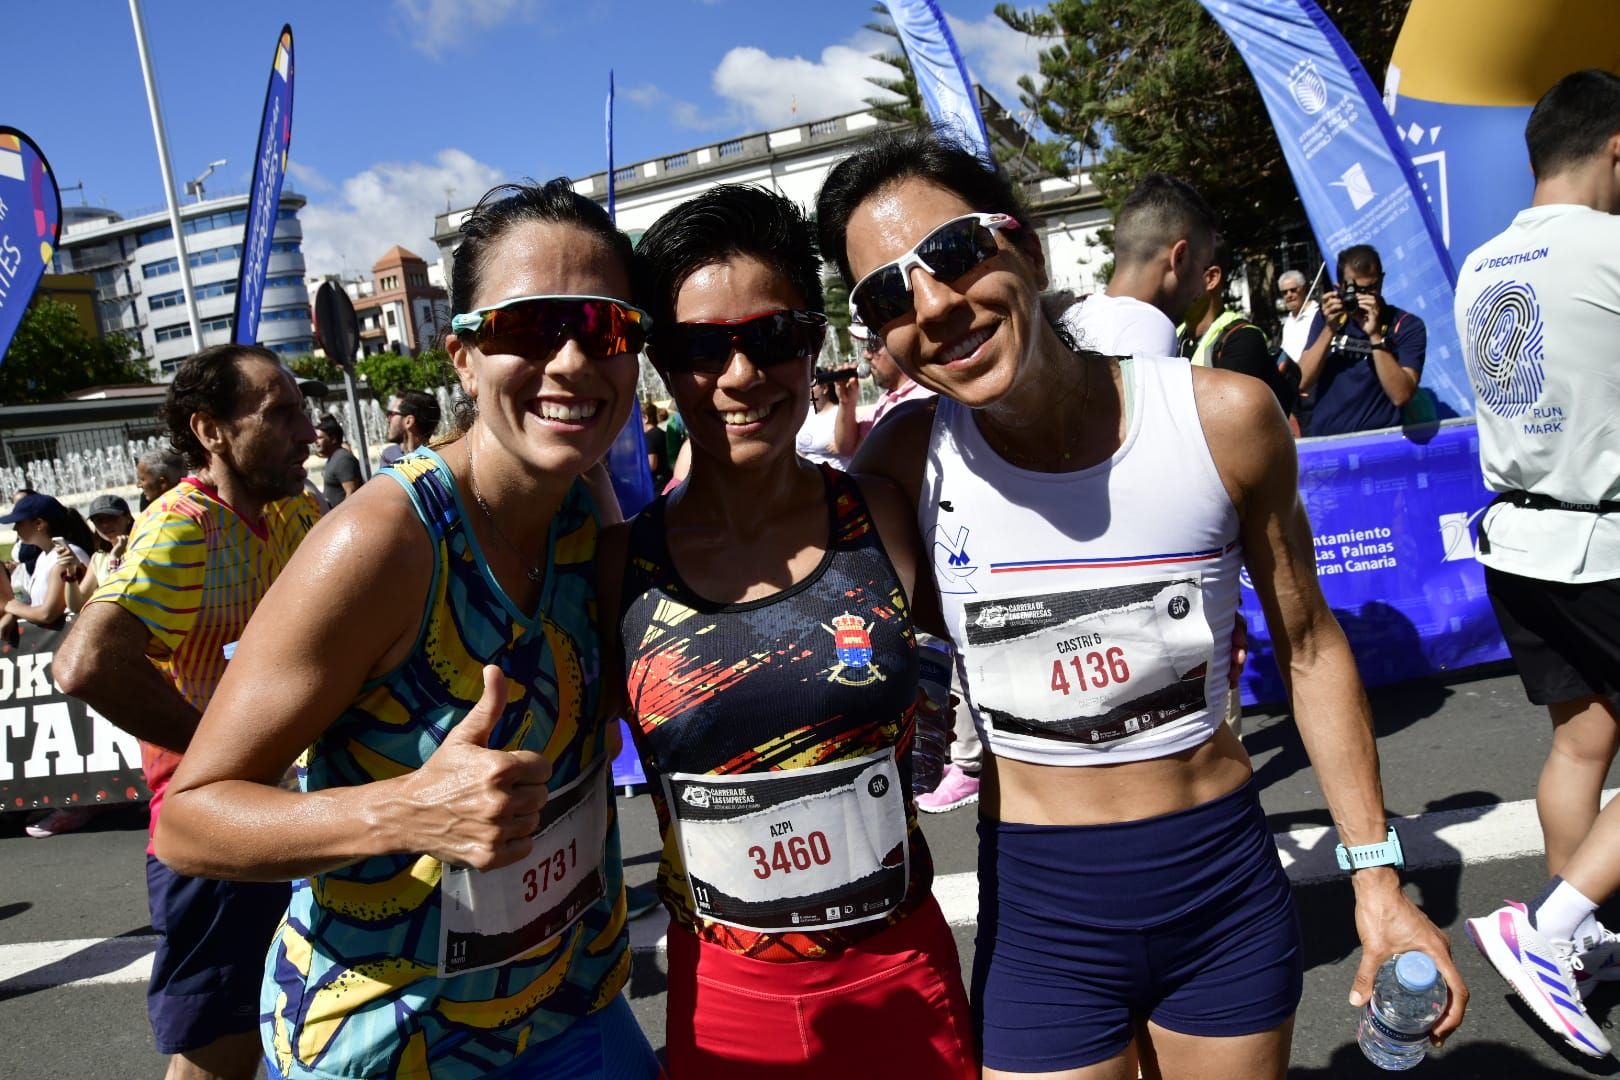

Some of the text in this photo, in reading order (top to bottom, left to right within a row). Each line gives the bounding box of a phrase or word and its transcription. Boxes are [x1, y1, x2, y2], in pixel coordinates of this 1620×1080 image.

[1488, 247, 1549, 269] DECATHLON
[1533, 406, 1563, 419] RUN
[1524, 422, 1564, 435] MARK
[1313, 526, 1391, 547] ntamiento
[1341, 542, 1395, 559] Palmas
[1345, 555, 1397, 573] Canaria
[1172, 601, 1186, 615] 5K
[1057, 633, 1102, 654] CASTRI 6
[1051, 646, 1131, 696] 4136
[769, 820, 794, 838] AZPI
[748, 831, 832, 880] 3460
[522, 838, 578, 903] 3731
[695, 886, 710, 903] 11
[452, 940, 467, 957] 11
